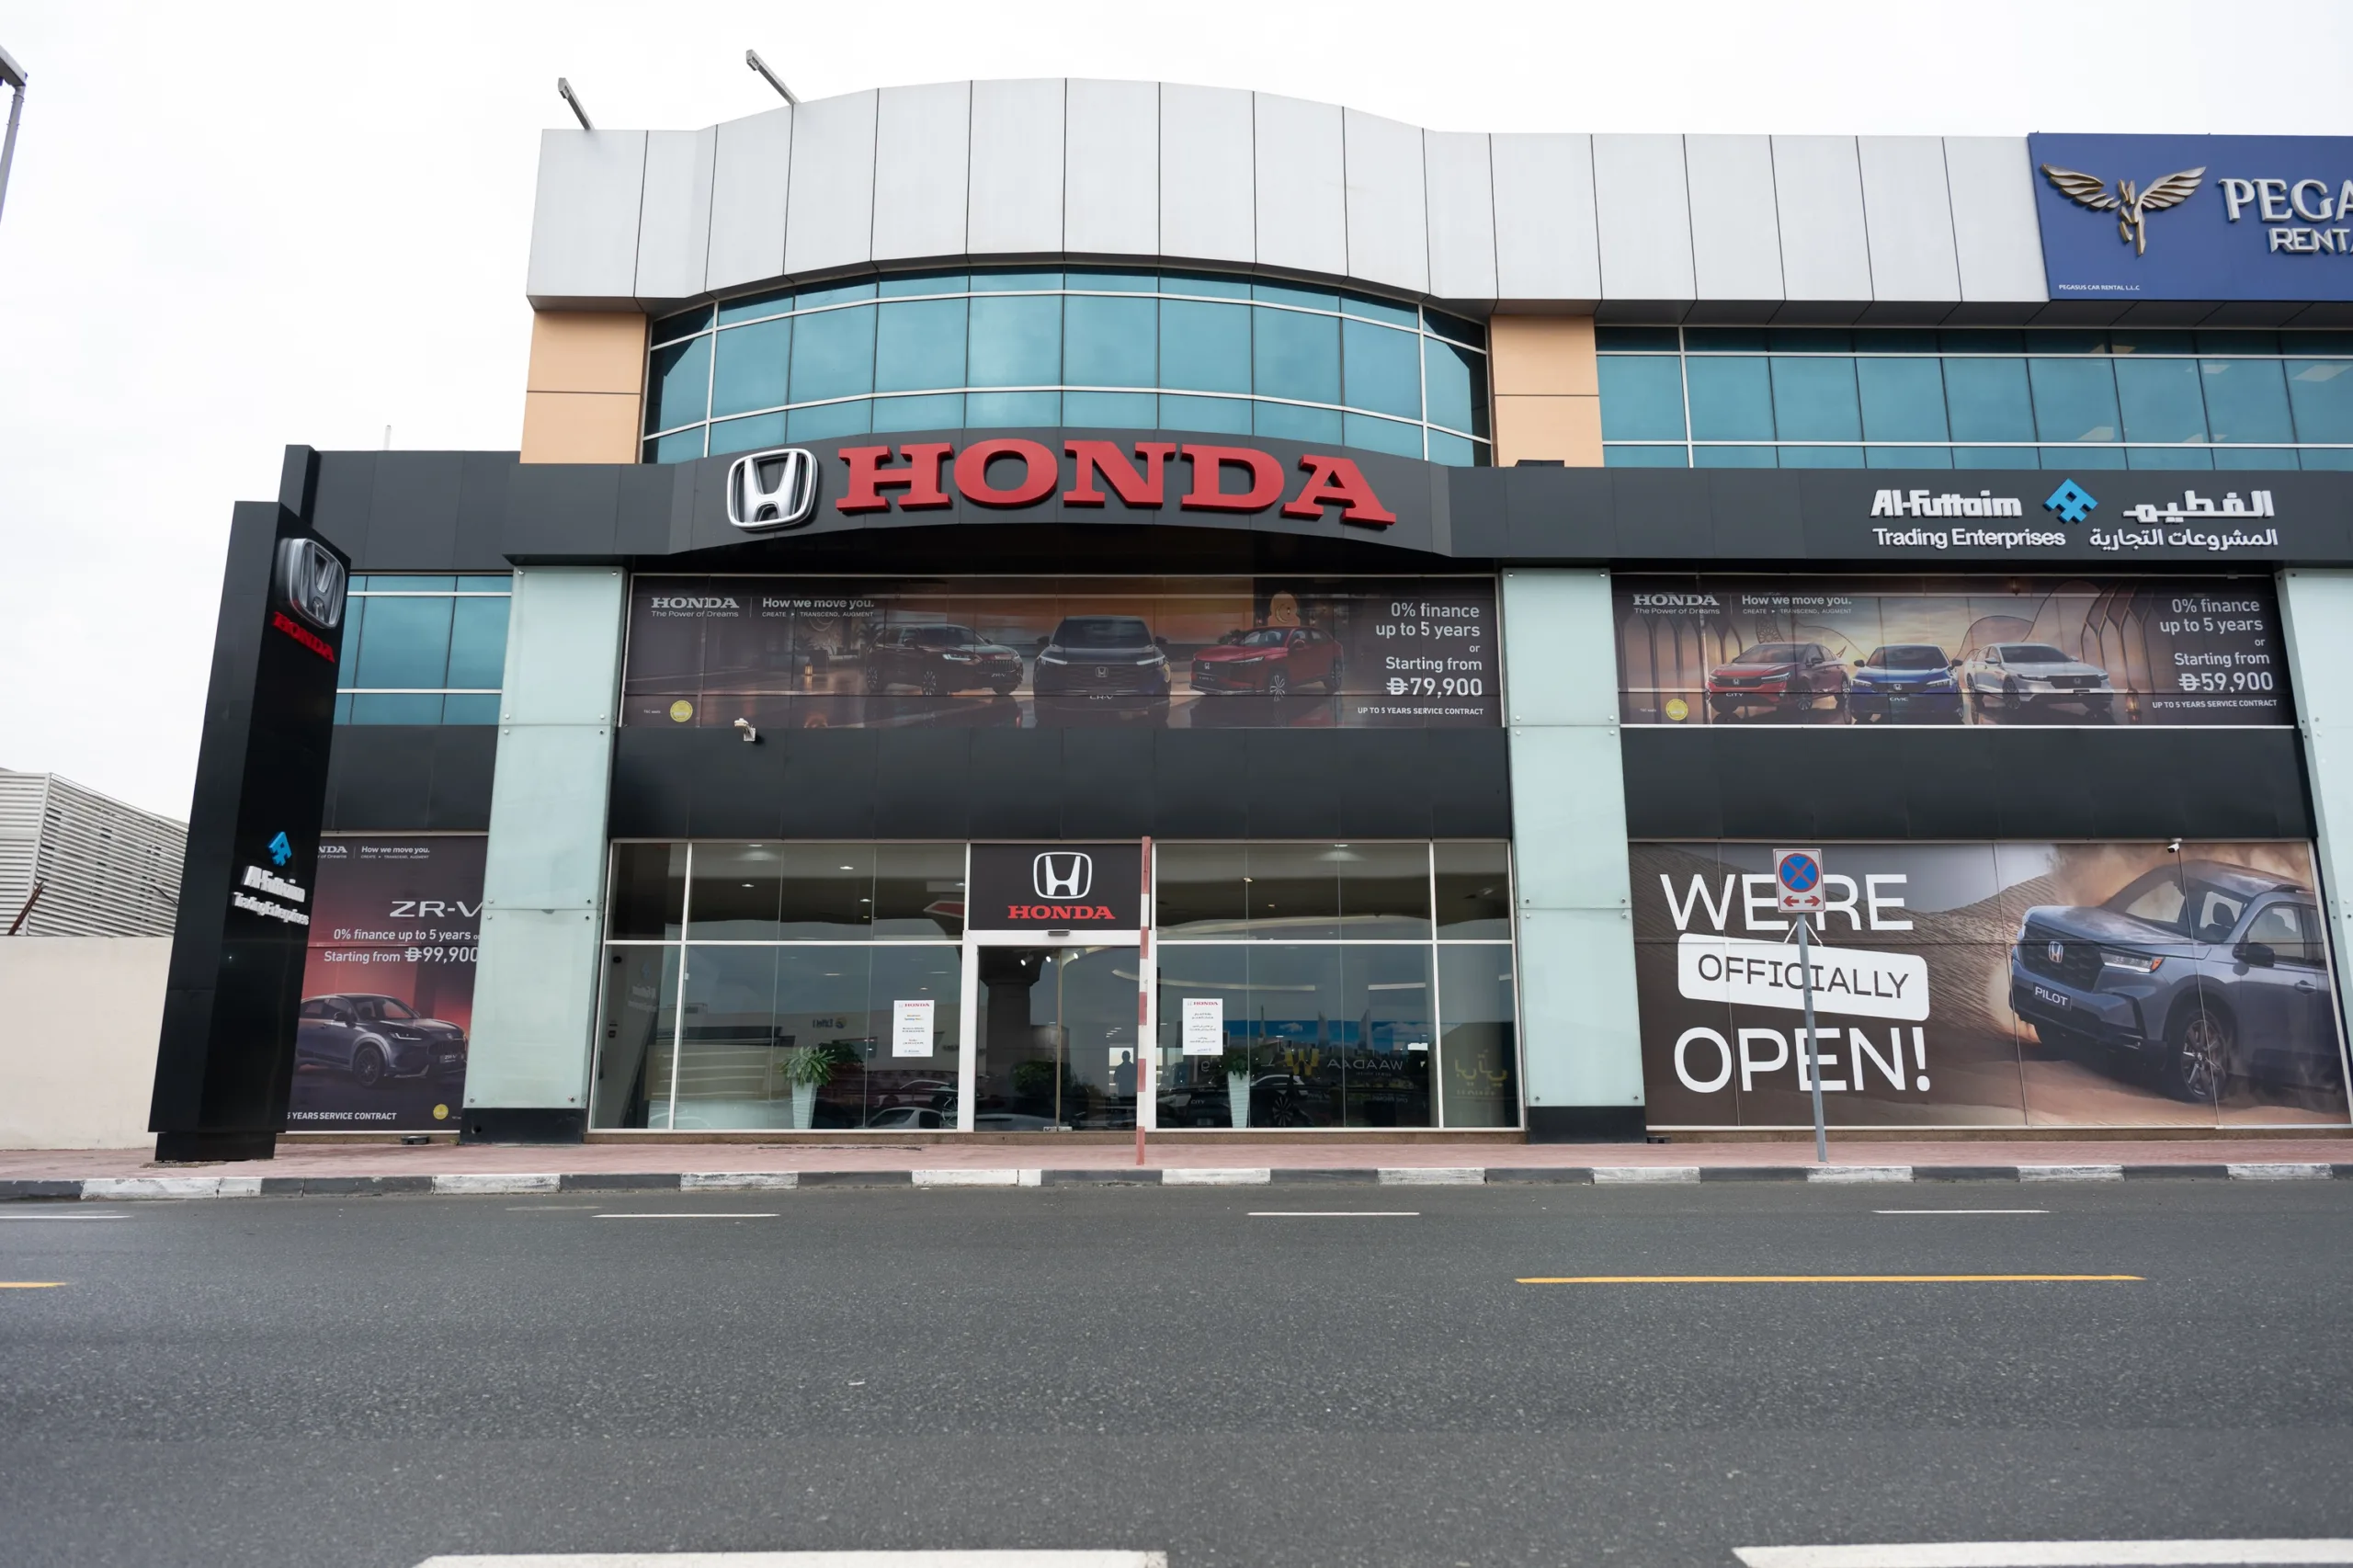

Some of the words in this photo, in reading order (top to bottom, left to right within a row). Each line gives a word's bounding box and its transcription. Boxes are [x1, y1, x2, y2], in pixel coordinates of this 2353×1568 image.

[2268, 227, 2353, 254] RENT
[835, 437, 1397, 527] HONDA
[1870, 489, 2023, 517] Al-Futtaim
[2122, 490, 2275, 524] الفطيم
[1872, 528, 1948, 549] Trading
[1951, 528, 2066, 549] Enterprises
[2089, 528, 2164, 551] التجارية
[2167, 528, 2279, 551] المشروعات
[651, 597, 739, 608] HONDA
[762, 598, 790, 608] How
[793, 599, 812, 608] we
[813, 599, 847, 608] move
[848, 600, 875, 610] you.
[1633, 594, 1720, 606] HONDA
[1742, 595, 1768, 605] How
[1771, 597, 1790, 605] we
[1792, 597, 1824, 605] move
[1826, 597, 1852, 607] you.
[2172, 599, 2197, 613] 0%
[2200, 599, 2260, 612] finance
[1391, 602, 1415, 617] 0%
[1420, 603, 1480, 618] finance
[1376, 625, 1395, 639] up
[1401, 622, 1415, 636] to
[1421, 621, 1429, 636] 5
[1434, 626, 1481, 640] years
[2160, 620, 2180, 635] up
[2184, 619, 2200, 631] to
[2203, 618, 2213, 631] 5
[2217, 619, 2263, 634] years
[273, 611, 335, 663] HONDA
[1386, 656, 1443, 673] Starting
[1447, 657, 1483, 671] from
[2174, 653, 2232, 667] Starting
[2234, 652, 2269, 665] from
[233, 892, 264, 915] Trading
[264, 901, 309, 925] Enterprises
[389, 901, 483, 917] ZR-V
[1007, 905, 1116, 919] HONDA
[334, 929, 351, 940] 0%
[354, 929, 395, 940] finance
[398, 932, 412, 942] up
[415, 930, 426, 940] to
[429, 929, 437, 940] 5
[438, 931, 471, 942] years
[324, 950, 369, 963] Starting
[372, 951, 400, 962] from
[1698, 954, 1909, 999] OFFICIALLY
[2034, 986, 2068, 1006] PILOT
[1674, 1027, 1930, 1093] OPEN!
